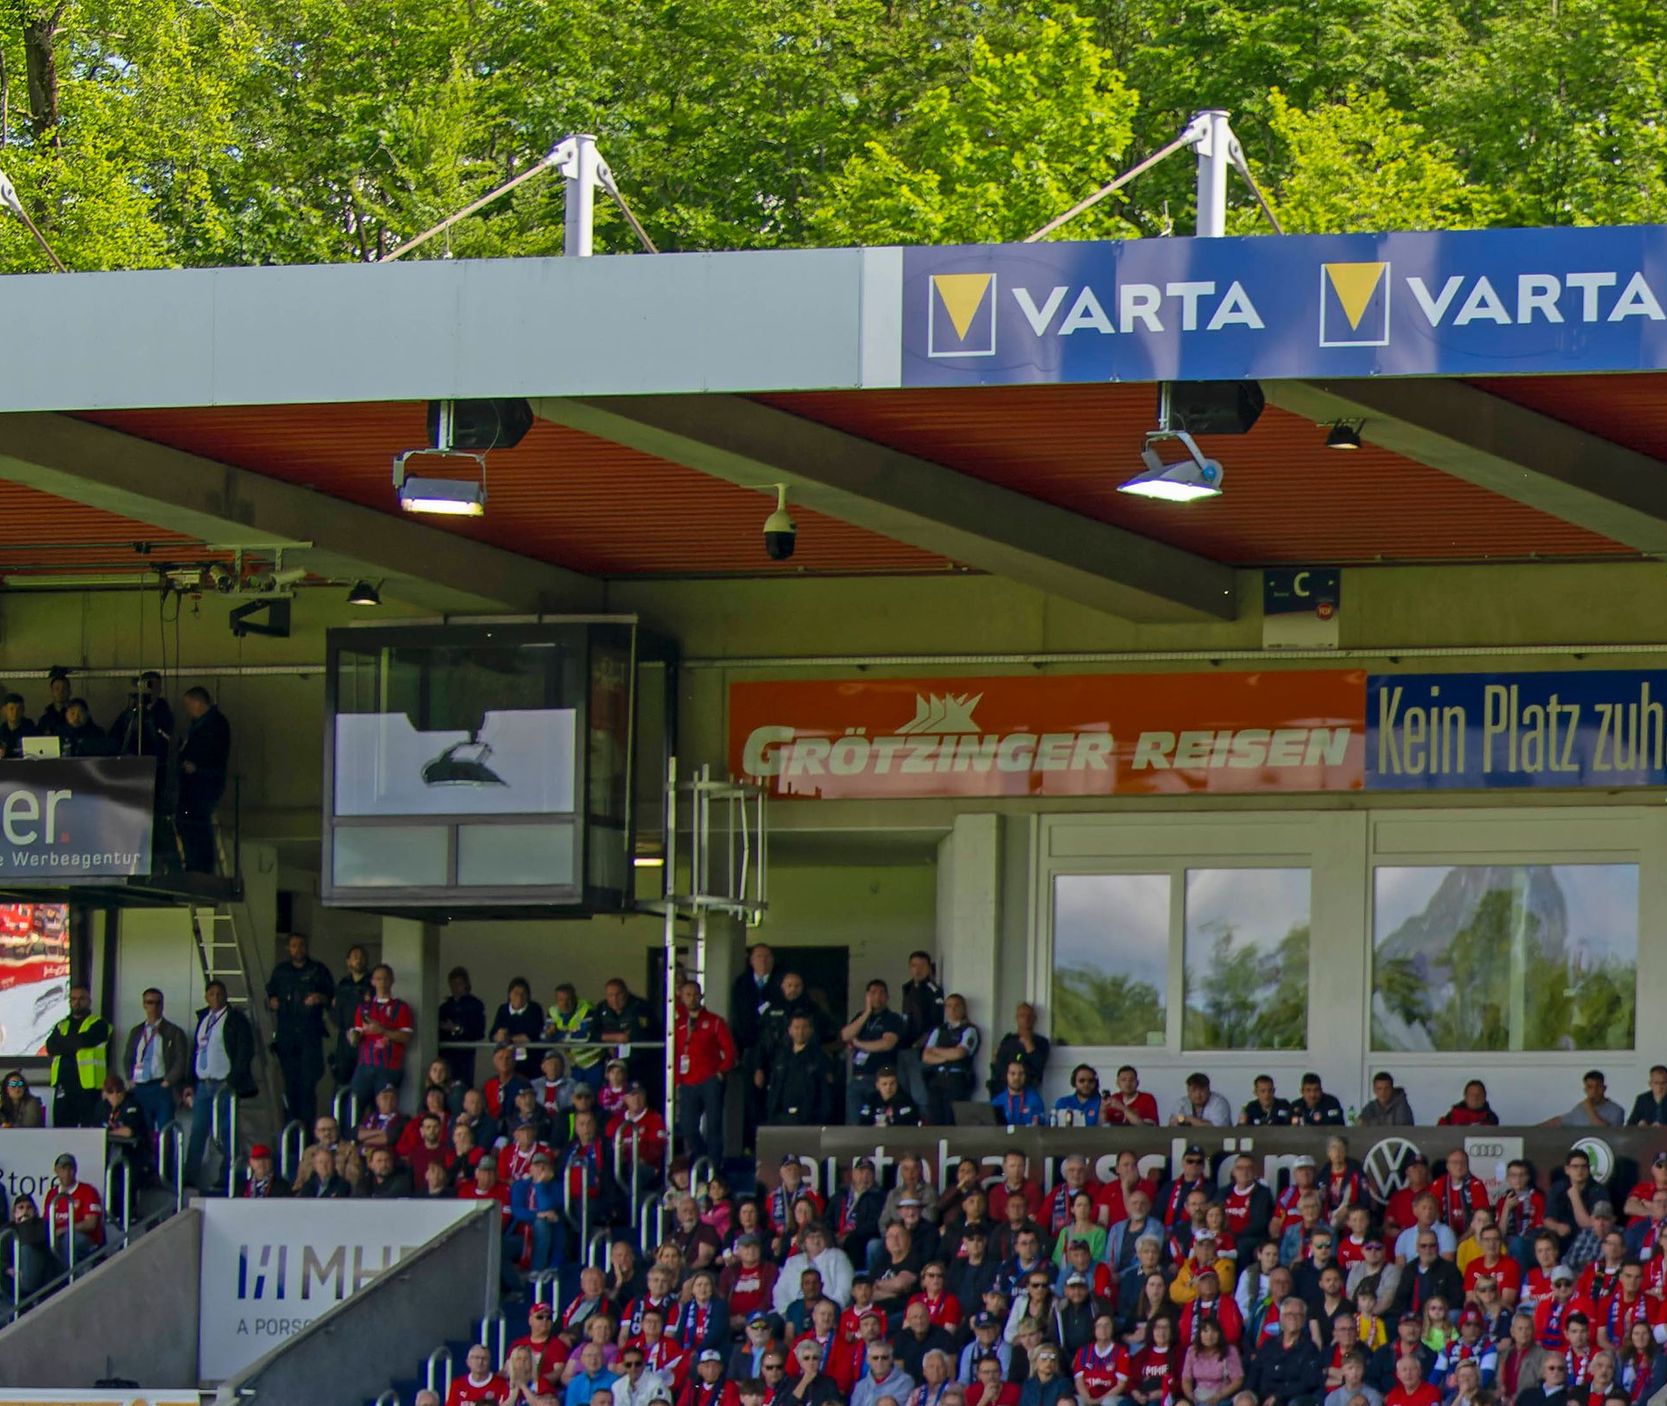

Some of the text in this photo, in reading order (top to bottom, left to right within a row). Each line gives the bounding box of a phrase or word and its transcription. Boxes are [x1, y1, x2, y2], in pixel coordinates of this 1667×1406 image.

[1012, 280, 1265, 334] VARTA
[1407, 271, 1666, 327] VARTA
[1293, 571, 1310, 597] C
[742, 726, 1350, 778] GRÖTZINGER REISEN
[1378, 684, 1466, 775] Kein
[1483, 683, 1581, 774] Platz
[13, 851, 141, 868] Werbeagentur
[302, 1245, 417, 1300] MH
